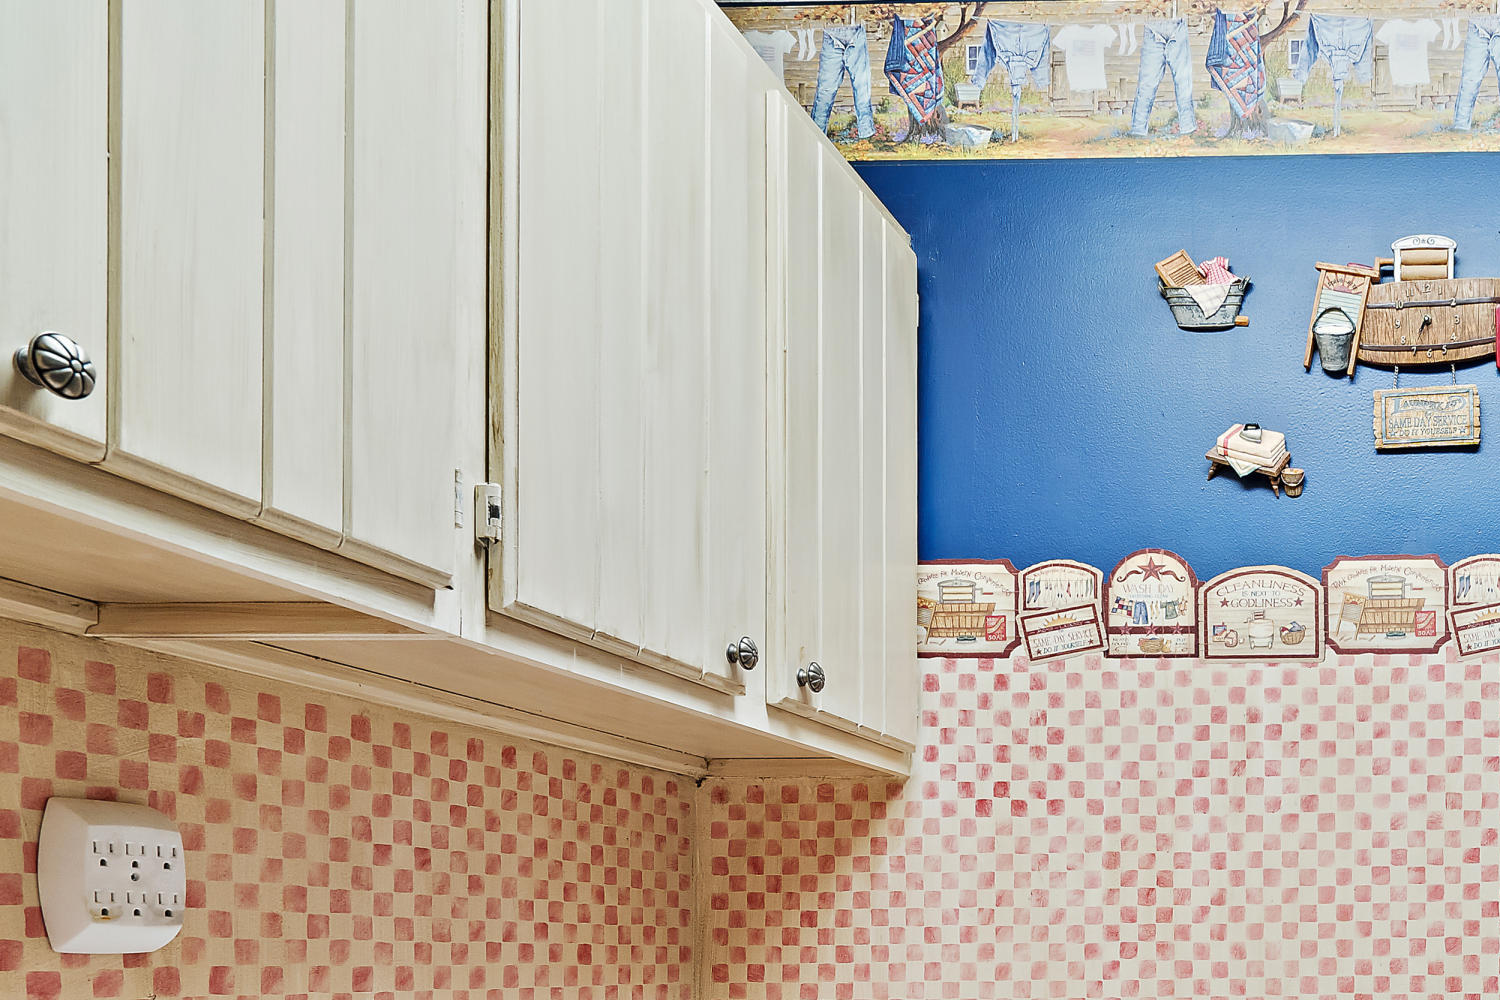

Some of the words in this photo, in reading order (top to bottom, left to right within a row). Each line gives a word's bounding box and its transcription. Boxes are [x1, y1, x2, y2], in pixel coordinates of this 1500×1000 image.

[1406, 288, 1414, 296] 11
[1422, 284, 1431, 293] 12
[1438, 286, 1442, 295] 1
[1395, 301, 1404, 309] 10
[1451, 297, 1456, 306] 2
[1396, 320, 1400, 328] 9
[1454, 315, 1460, 324] 3
[1400, 336, 1406, 344] 8
[1450, 332, 1457, 340] 4
[1411, 346, 1416, 356] 7
[1426, 349, 1432, 358] 6
[1442, 345, 1447, 354] 5
[1388, 417, 1412, 429] SAME
[1414, 416, 1432, 428] DAY
[1432, 414, 1468, 427] SERVICE
[1420, 427, 1458, 436] YOURSELF
[1122, 584, 1152, 592] WASH
[1158, 584, 1174, 592] DAY
[1216, 580, 1306, 597] CLEANLINESS
[1230, 598, 1294, 608] GODLINESS
[1034, 636, 1050, 648] SAME
[1068, 628, 1092, 640] SERVICE
[1464, 632, 1480, 643] SAME
[1062, 641, 1086, 649] YOURSELF
